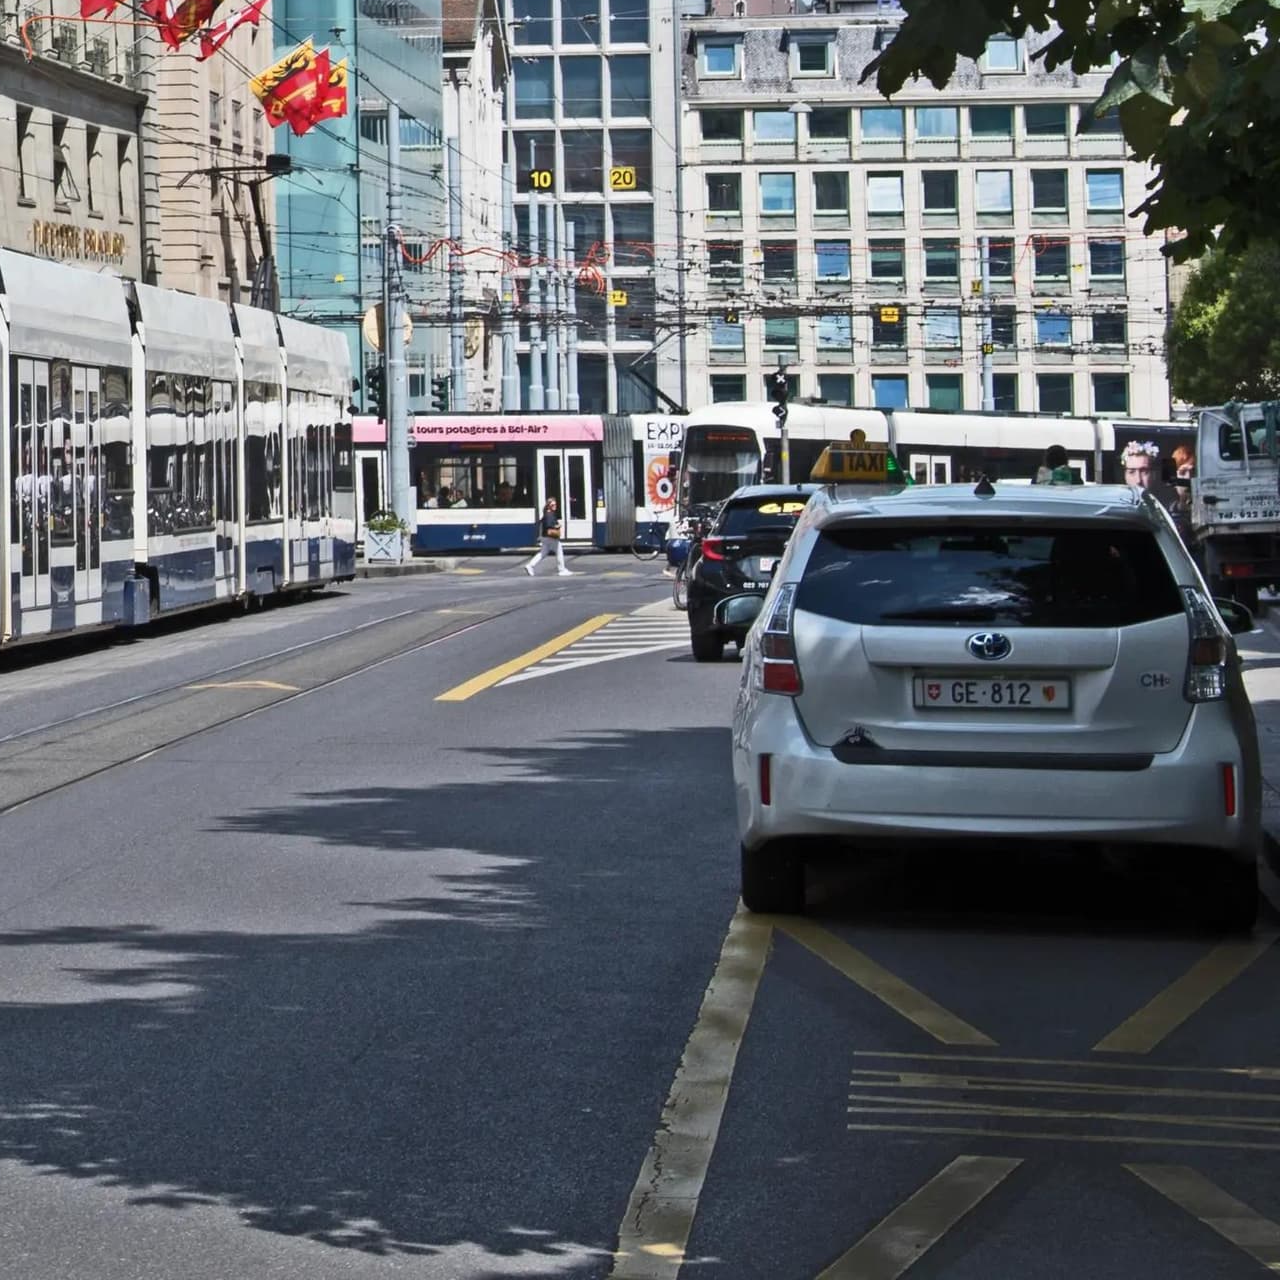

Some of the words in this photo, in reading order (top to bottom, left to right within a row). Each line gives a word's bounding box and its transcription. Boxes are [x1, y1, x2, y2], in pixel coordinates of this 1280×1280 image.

[531, 171, 552, 188] 10
[612, 170, 633, 186] 20
[416, 426, 444, 434] tours
[445, 424, 498, 436] potagères
[499, 424, 506, 434] à
[848, 452, 884, 472] TAXI
[1141, 673, 1166, 688] CH
